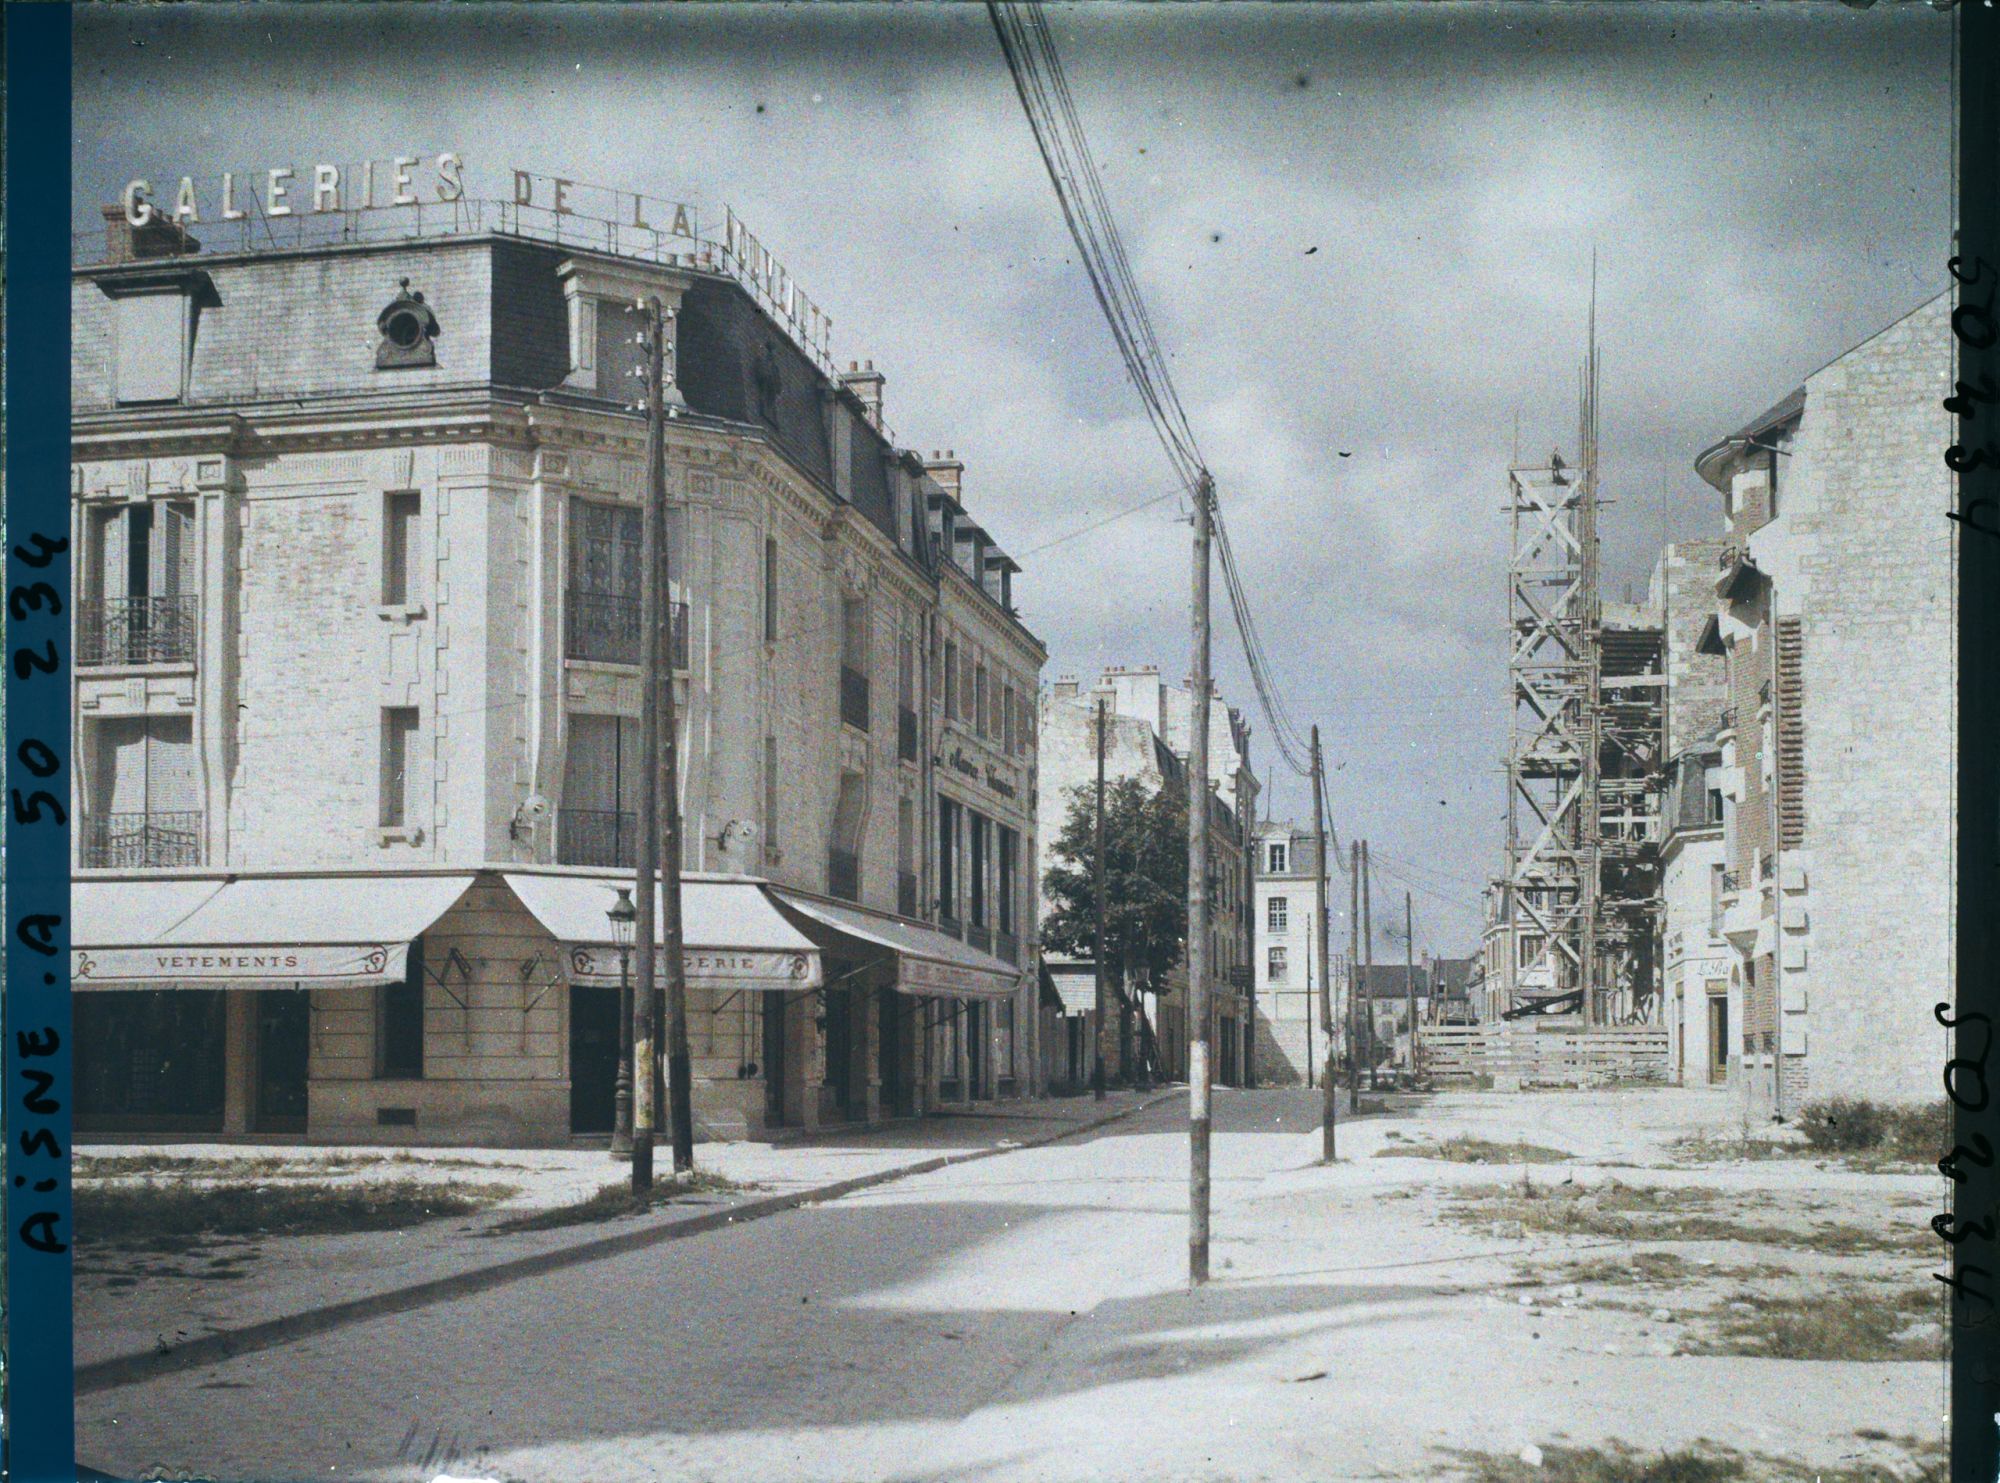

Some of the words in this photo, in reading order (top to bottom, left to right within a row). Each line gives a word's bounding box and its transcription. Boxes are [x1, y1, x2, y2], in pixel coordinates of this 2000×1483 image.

[124, 153, 463, 226] GALERIES
[514, 170, 574, 214] DE
[633, 194, 691, 238] LA
[1943, 256, 2000, 540] 50234
[12, 531, 69, 681] 234
[13, 739, 66, 825] 50
[156, 956, 298, 968] VETEMENTS
